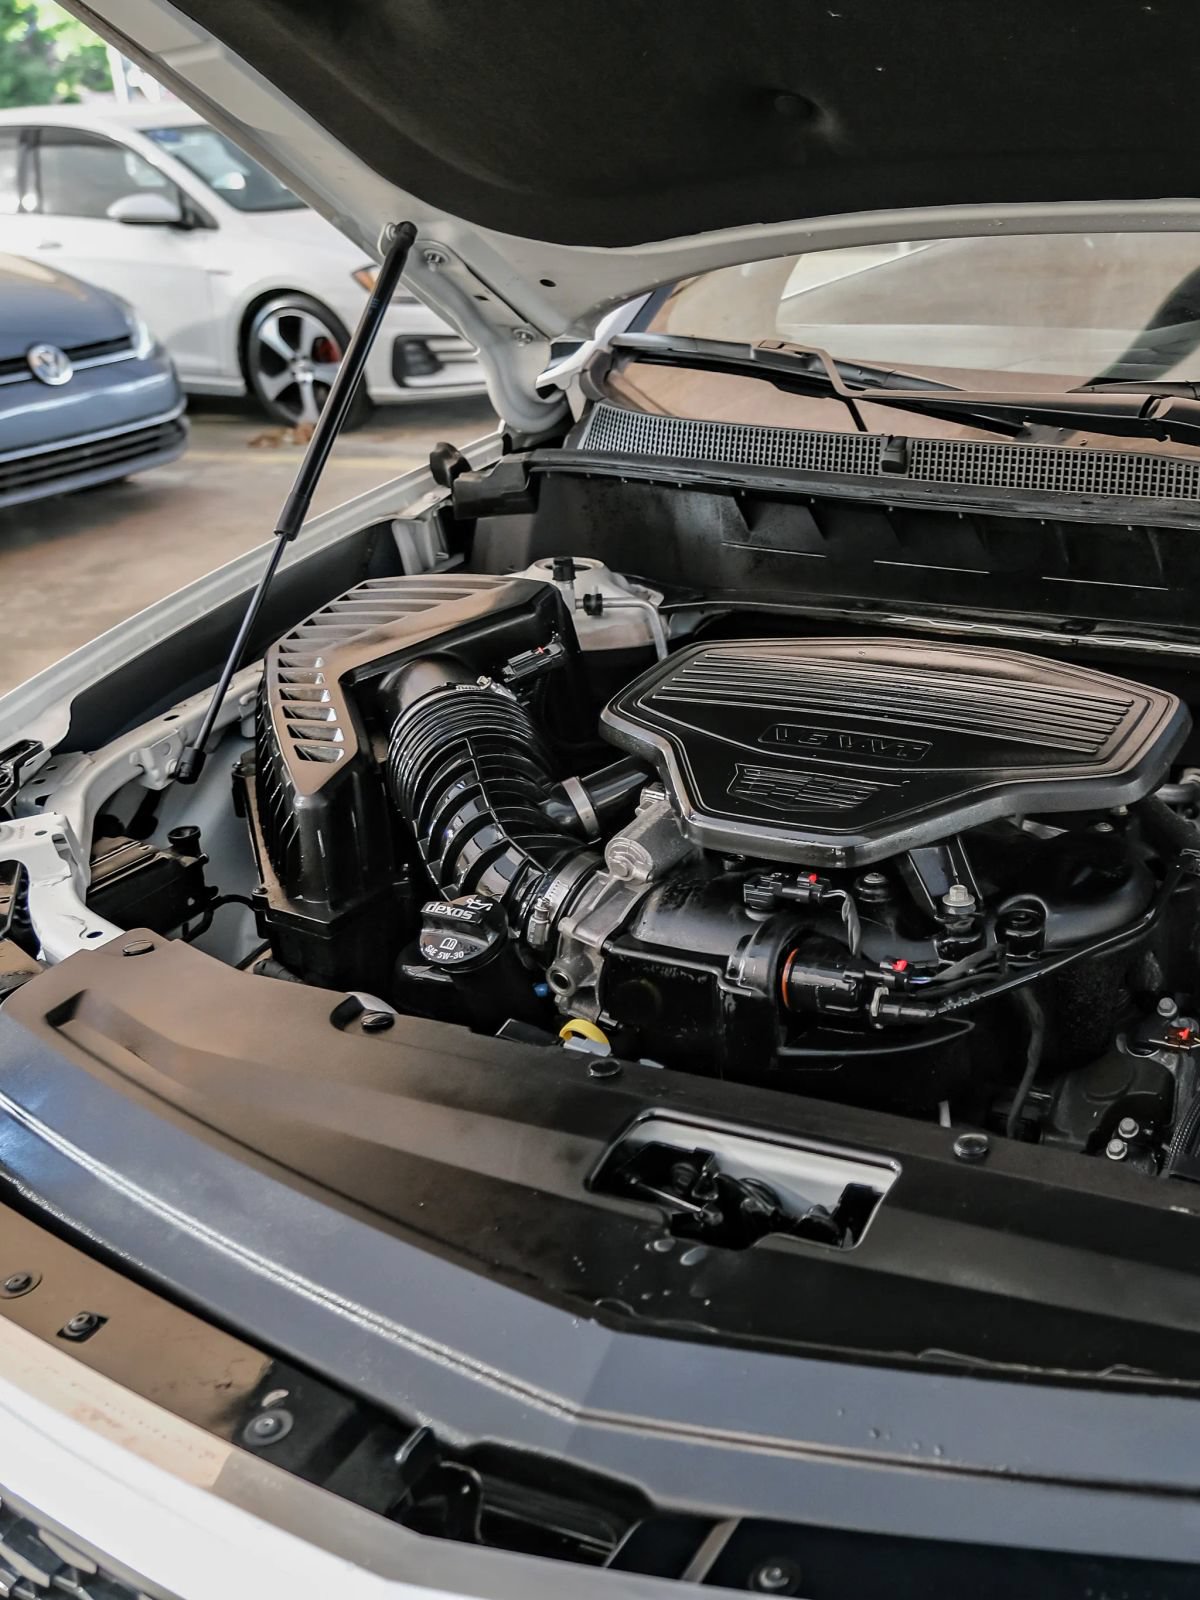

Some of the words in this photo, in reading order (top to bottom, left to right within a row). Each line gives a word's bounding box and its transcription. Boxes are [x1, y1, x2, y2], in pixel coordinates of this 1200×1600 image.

[426, 902, 476, 920] dexos
[425, 944, 438, 956] SAE
[437, 951, 464, 960] 5W-30
